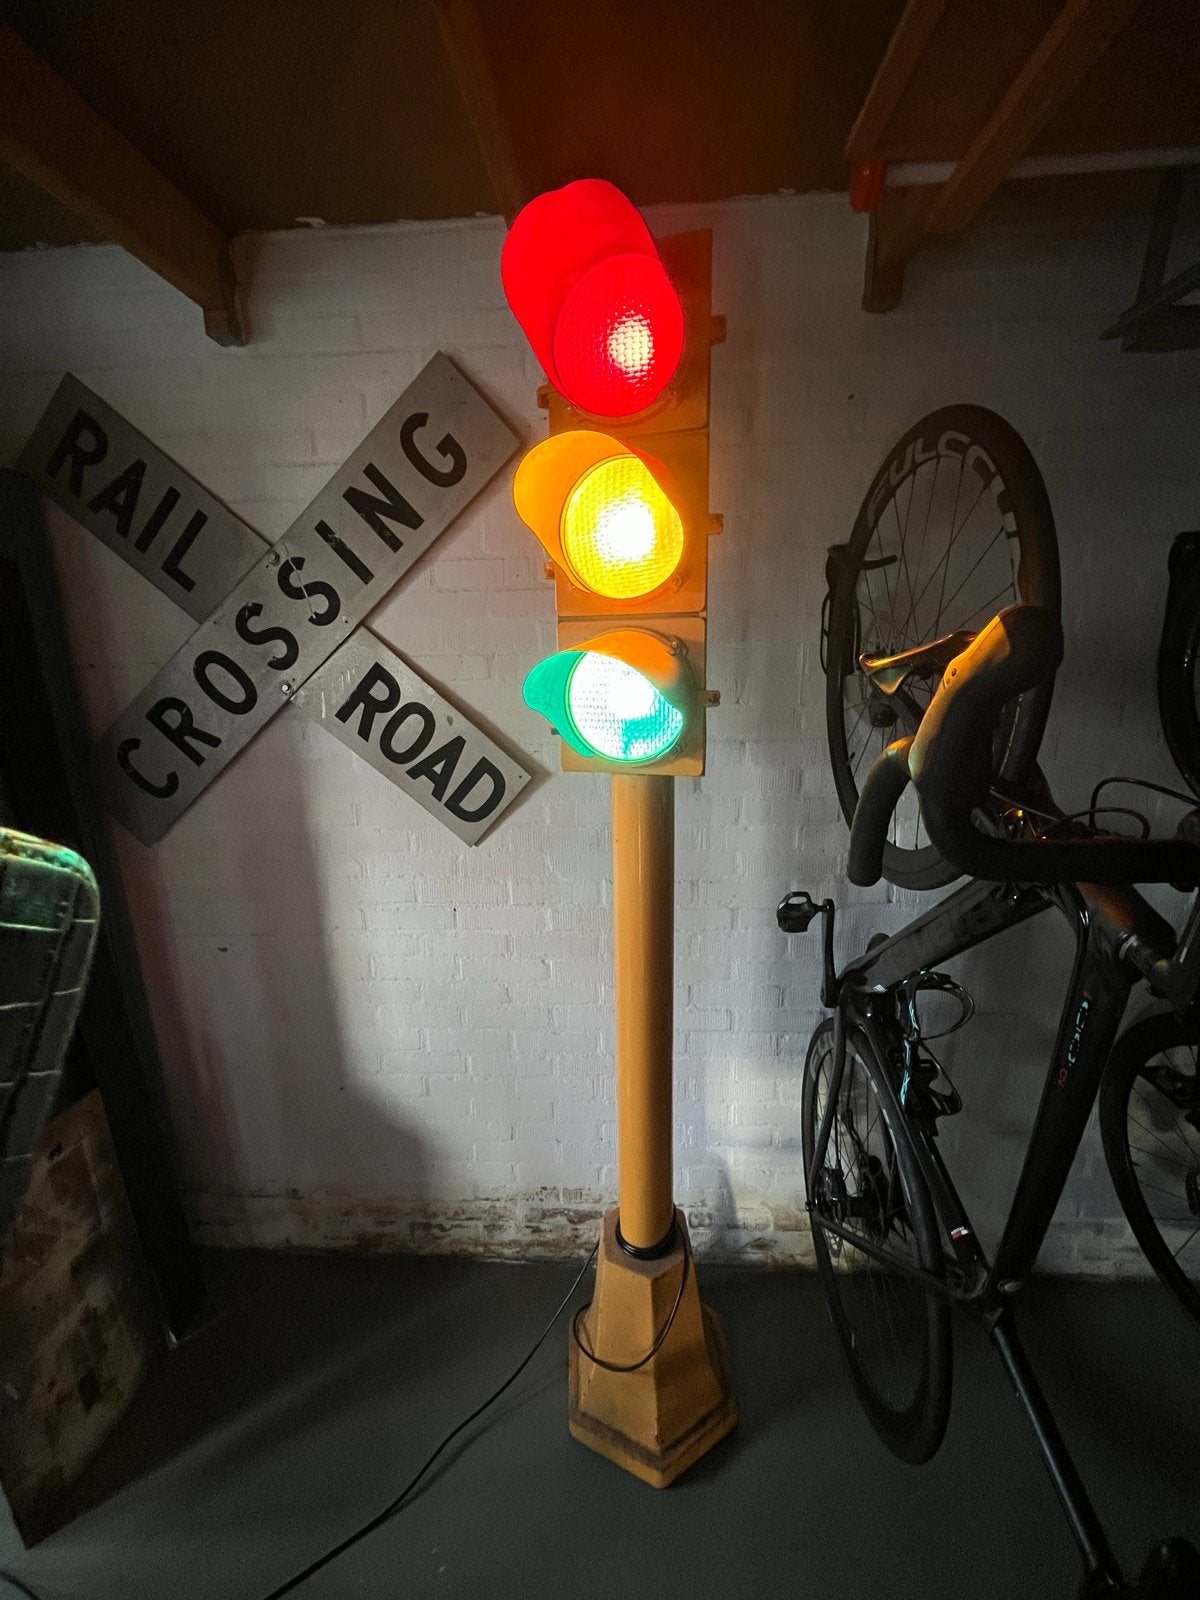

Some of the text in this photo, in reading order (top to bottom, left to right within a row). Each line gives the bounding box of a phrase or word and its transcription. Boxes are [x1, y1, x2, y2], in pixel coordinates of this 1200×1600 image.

[48, 409, 208, 592] RAIL
[117, 412, 468, 799] CROSSING
[335, 661, 507, 823] ROAD
